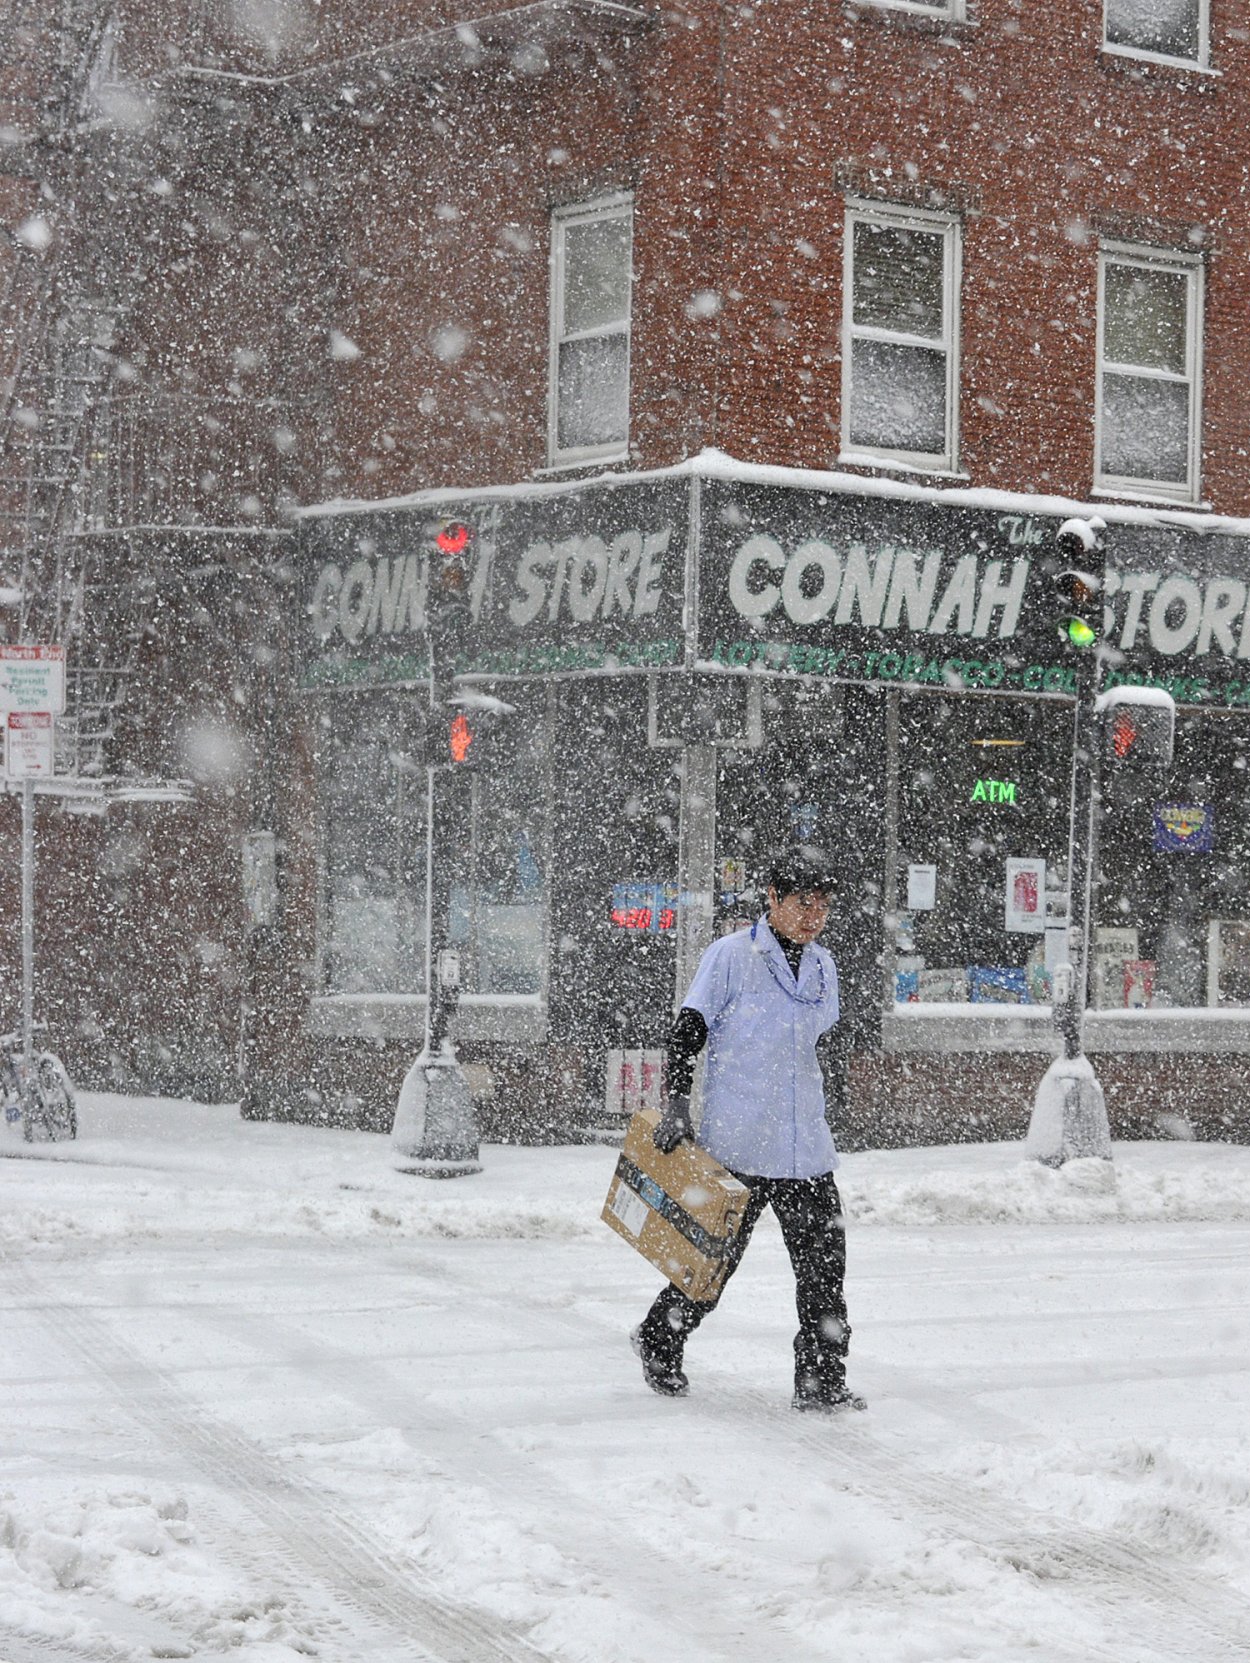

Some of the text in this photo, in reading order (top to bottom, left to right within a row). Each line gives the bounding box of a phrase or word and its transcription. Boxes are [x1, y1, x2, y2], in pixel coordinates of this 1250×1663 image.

[311, 529, 671, 645] CONN STORE
[729, 533, 1030, 639] CONNAH
[864, 652, 1004, 688] TOBACCO
[1023, 665, 1080, 693] COL
[970, 779, 1017, 804] ATM
